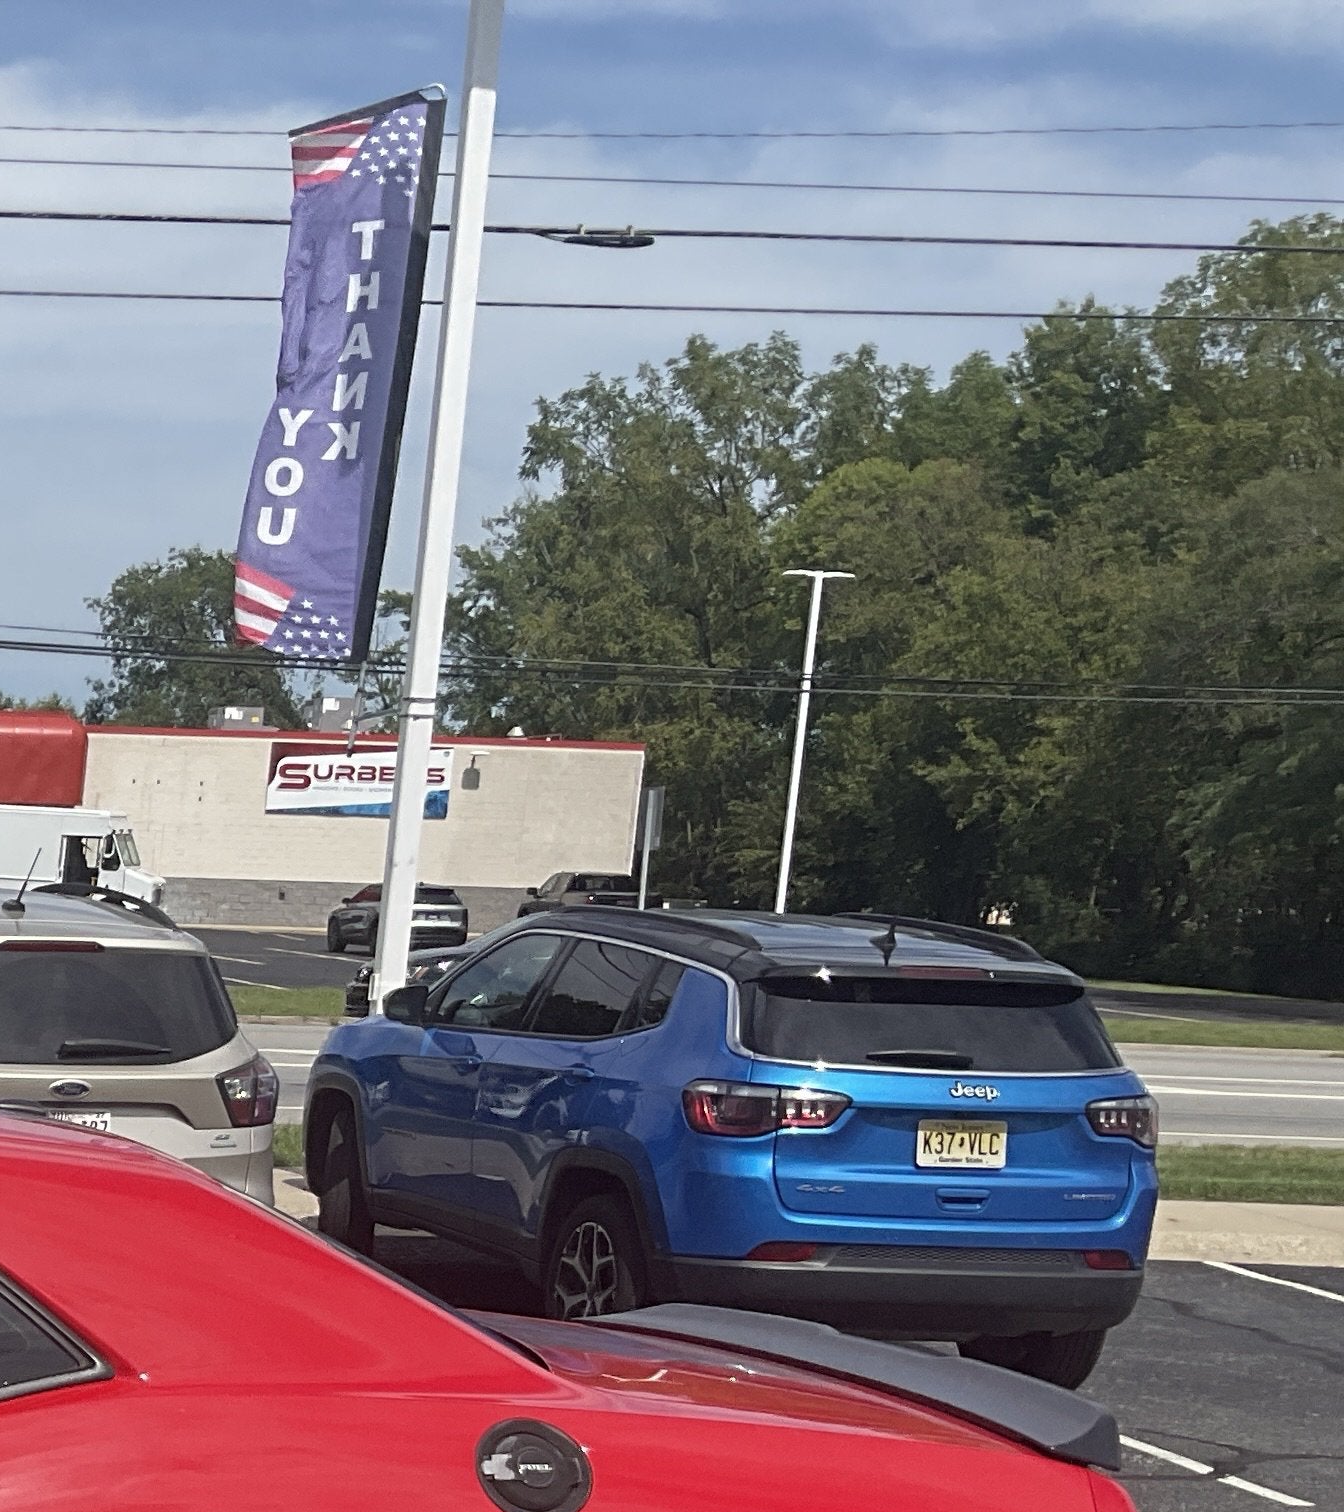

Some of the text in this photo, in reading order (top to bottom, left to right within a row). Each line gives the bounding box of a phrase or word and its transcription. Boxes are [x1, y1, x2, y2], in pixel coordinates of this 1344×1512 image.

[277, 763, 446, 792] SURBES
[949, 1080, 999, 1101] Jeep
[923, 1132, 1000, 1155] K37 VLC
